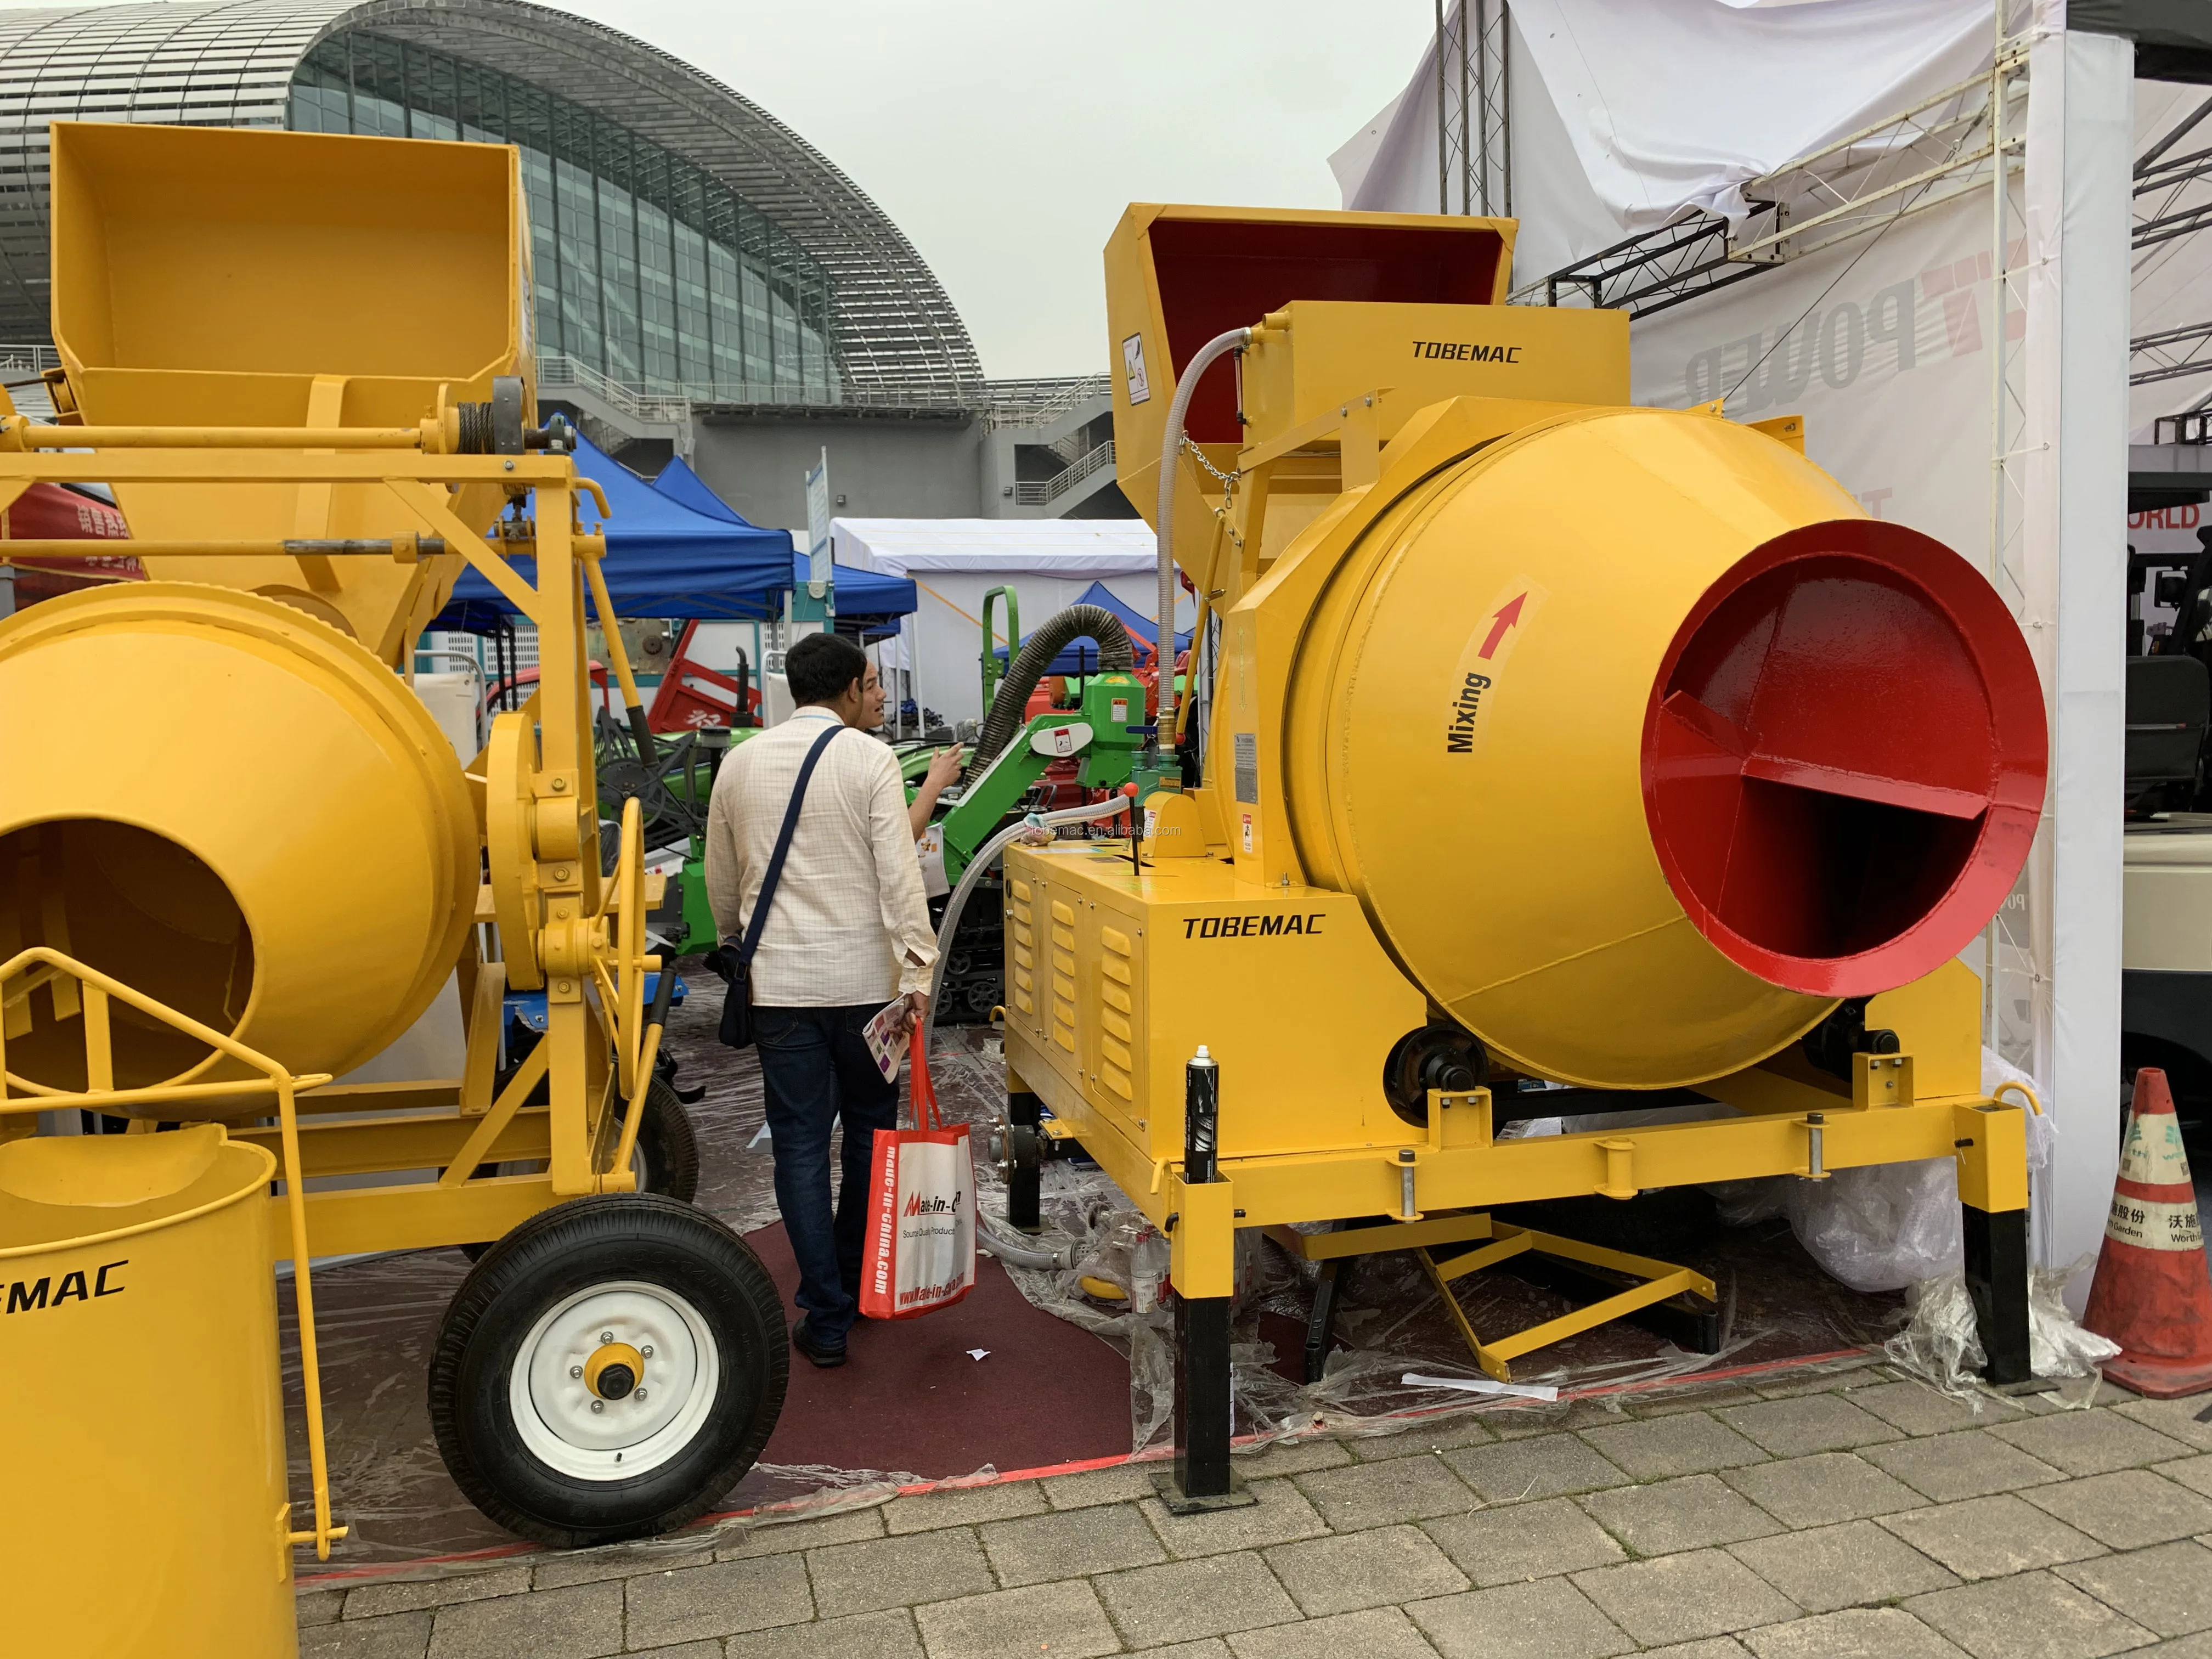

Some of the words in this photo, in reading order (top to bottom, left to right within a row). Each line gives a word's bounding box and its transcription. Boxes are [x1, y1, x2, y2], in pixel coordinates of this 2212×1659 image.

[1413, 341, 1522, 363] TOBEMAC
[1447, 672, 1492, 753] Mixing
[1183, 913, 1327, 939] TOBEMAC
[2114, 1222, 2142, 1238] Garden
[2169, 1213, 2199, 1228] 沃施
[2171, 1233, 2198, 1243] Worth
[0, 1259, 129, 1314] MAC
